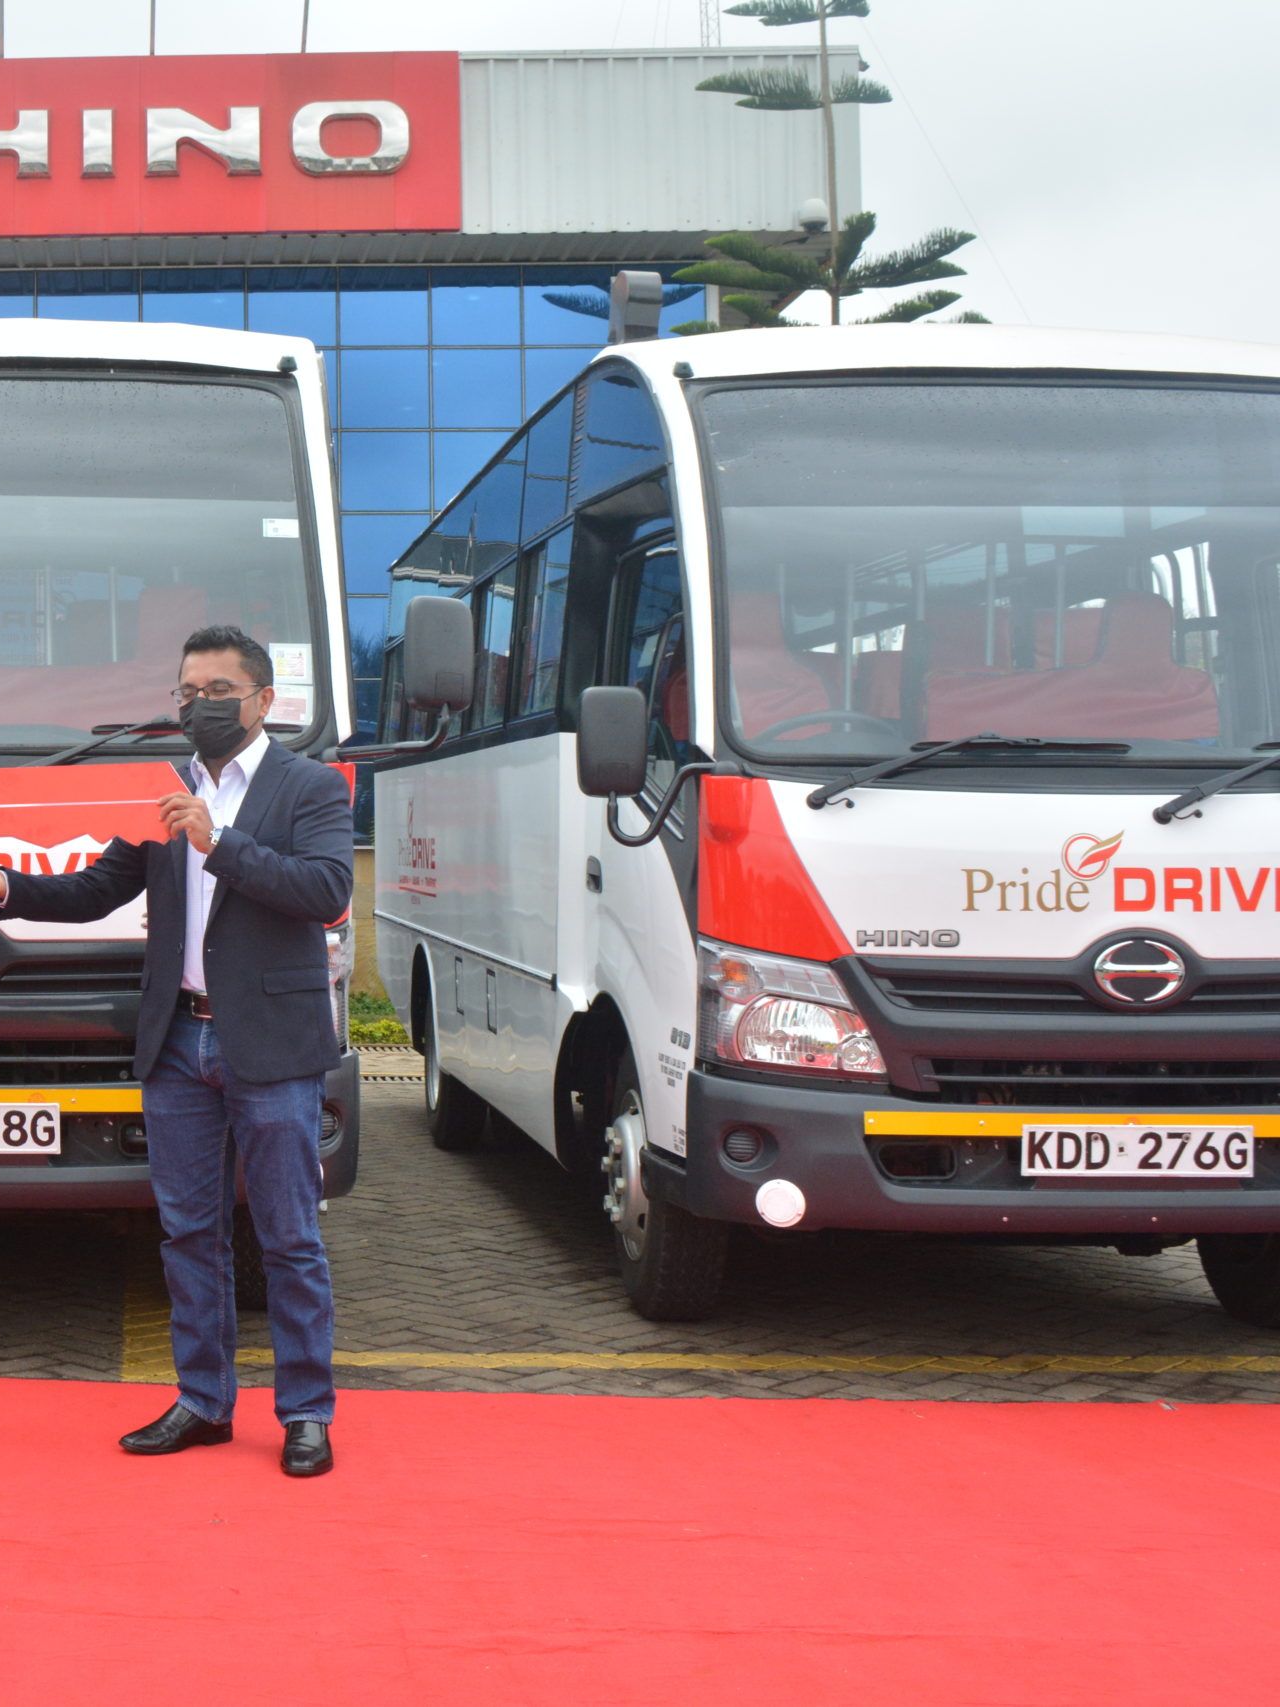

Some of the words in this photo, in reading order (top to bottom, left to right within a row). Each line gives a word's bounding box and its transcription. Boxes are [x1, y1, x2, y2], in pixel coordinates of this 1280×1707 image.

[412, 838, 436, 869] DRIVE
[961, 867, 1091, 913] Pride
[1113, 866, 1280, 912] DRIV
[856, 929, 961, 949] HINO
[1027, 1131, 1110, 1170] KDD
[1137, 1131, 1248, 1170] 276G
